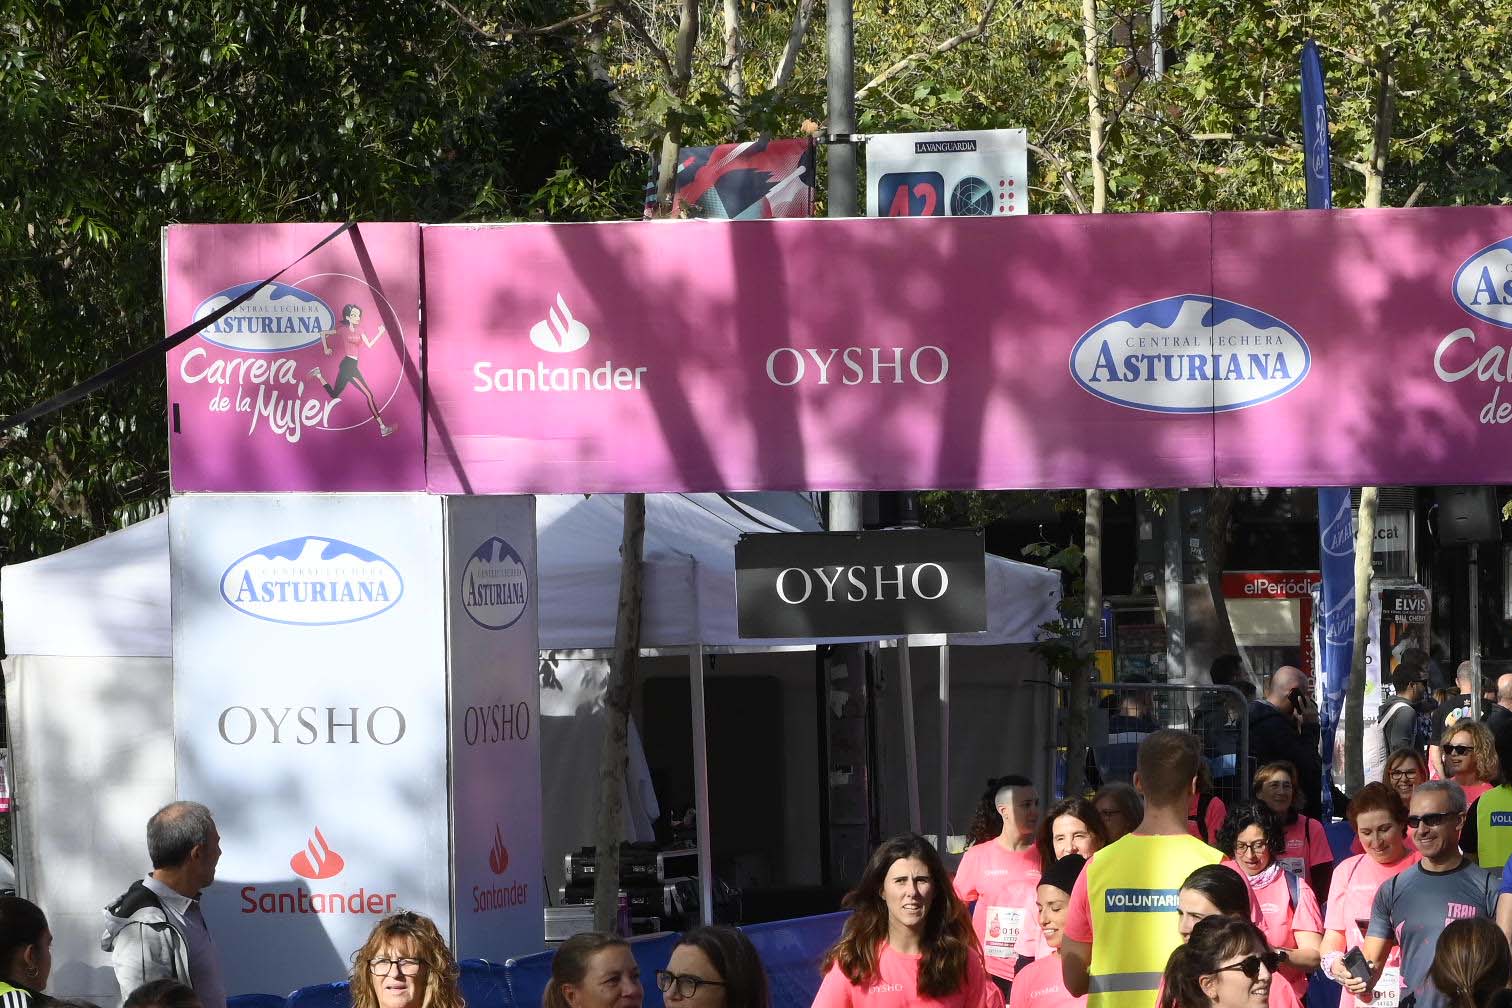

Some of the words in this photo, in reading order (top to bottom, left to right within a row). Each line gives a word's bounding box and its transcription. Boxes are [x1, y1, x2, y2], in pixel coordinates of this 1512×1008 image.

[1126, 335, 1200, 348] CENTRAL
[180, 347, 298, 384] Carrera
[473, 361, 647, 393] Santander
[765, 345, 950, 386] OYSHO
[1088, 340, 1292, 383] ASTURIANA
[209, 391, 230, 412] de
[235, 385, 251, 412] la
[249, 382, 342, 443] Mujer
[1480, 387, 1512, 425] de
[235, 568, 390, 603] ASTURIANA
[466, 573, 525, 607] ASTURIANA
[775, 561, 950, 605] OYSHO
[1395, 598, 1426, 611] ELVIS
[217, 705, 407, 746] OYSHO
[463, 701, 531, 746] OYSHO
[241, 886, 397, 915] Santander
[472, 880, 529, 913] Santander
[1106, 894, 1181, 908] VOLUNTARI
[1002, 927, 1020, 936] 016
